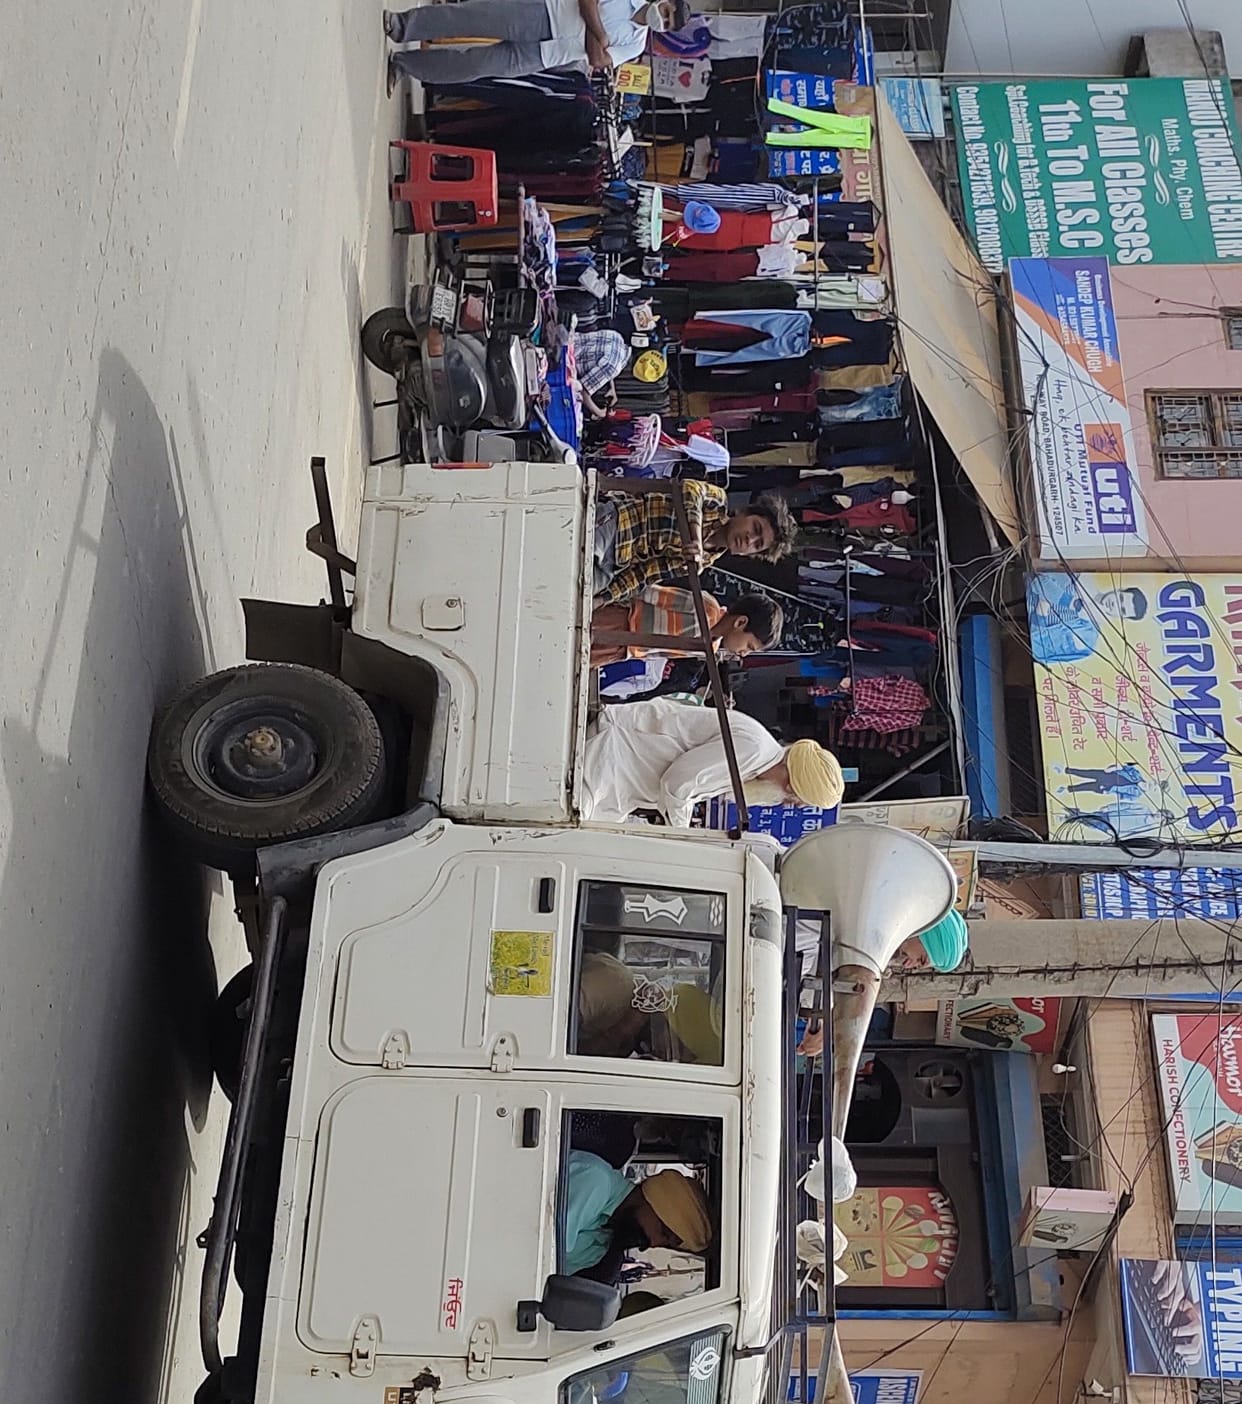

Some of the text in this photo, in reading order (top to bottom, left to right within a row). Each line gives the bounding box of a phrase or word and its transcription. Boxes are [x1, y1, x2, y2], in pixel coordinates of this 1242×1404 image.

[956, 86, 982, 125] Contact
[1038, 100, 1083, 142] 11th
[1014, 144, 1036, 158] for
[1046, 145, 1089, 176] To
[1086, 83, 1154, 265] For All Classes
[1160, 118, 1195, 220] Maths. Phy. Chem
[1182, 79, 1242, 258] MANOJ COACHING CENTRE
[1051, 180, 1104, 249] M.S.C
[1074, 270, 1103, 373] SANDEP KUMAR CHUGH
[1077, 449, 1092, 496] Mutual
[1094, 467, 1132, 525] uti
[1052, 506, 1063, 536] 124507
[1083, 500, 1097, 535] Fund
[1155, 580, 1238, 833] GARMENTS
[1162, 1039, 1191, 1184] HARISH CONFECTIONERY
[1205, 1268, 1242, 1373] TYPING
